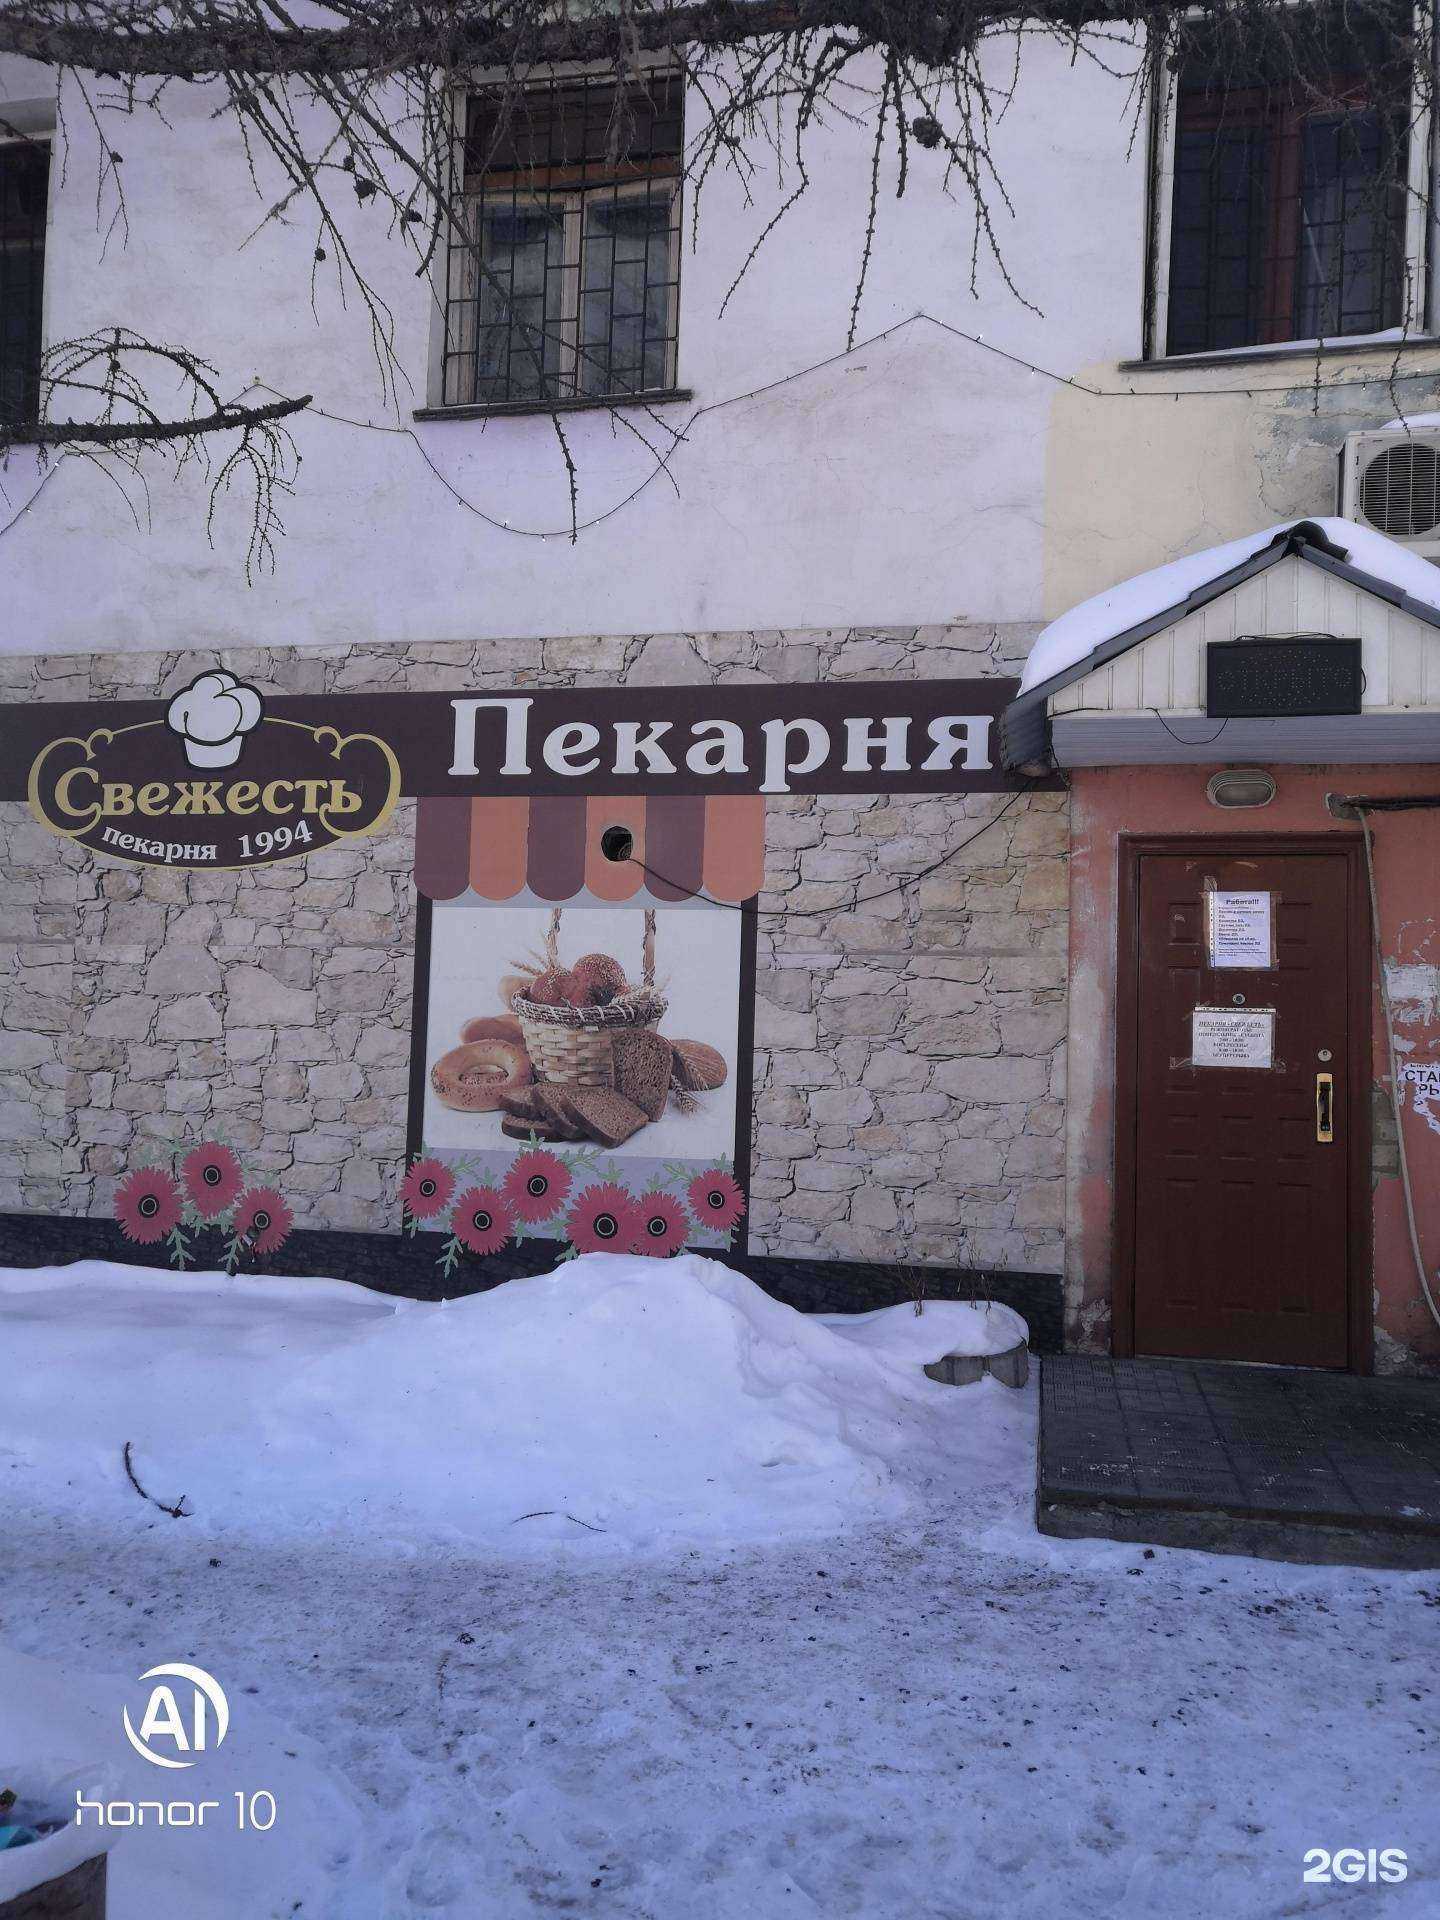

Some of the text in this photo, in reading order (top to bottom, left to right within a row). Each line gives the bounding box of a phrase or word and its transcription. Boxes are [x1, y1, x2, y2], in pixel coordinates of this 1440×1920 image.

[447, 697, 995, 792] Пекарня
[54, 766, 363, 817] Свежесть
[101, 819, 313, 863] пекарня 1994
[1405, 1070, 1440, 1083] СТА
